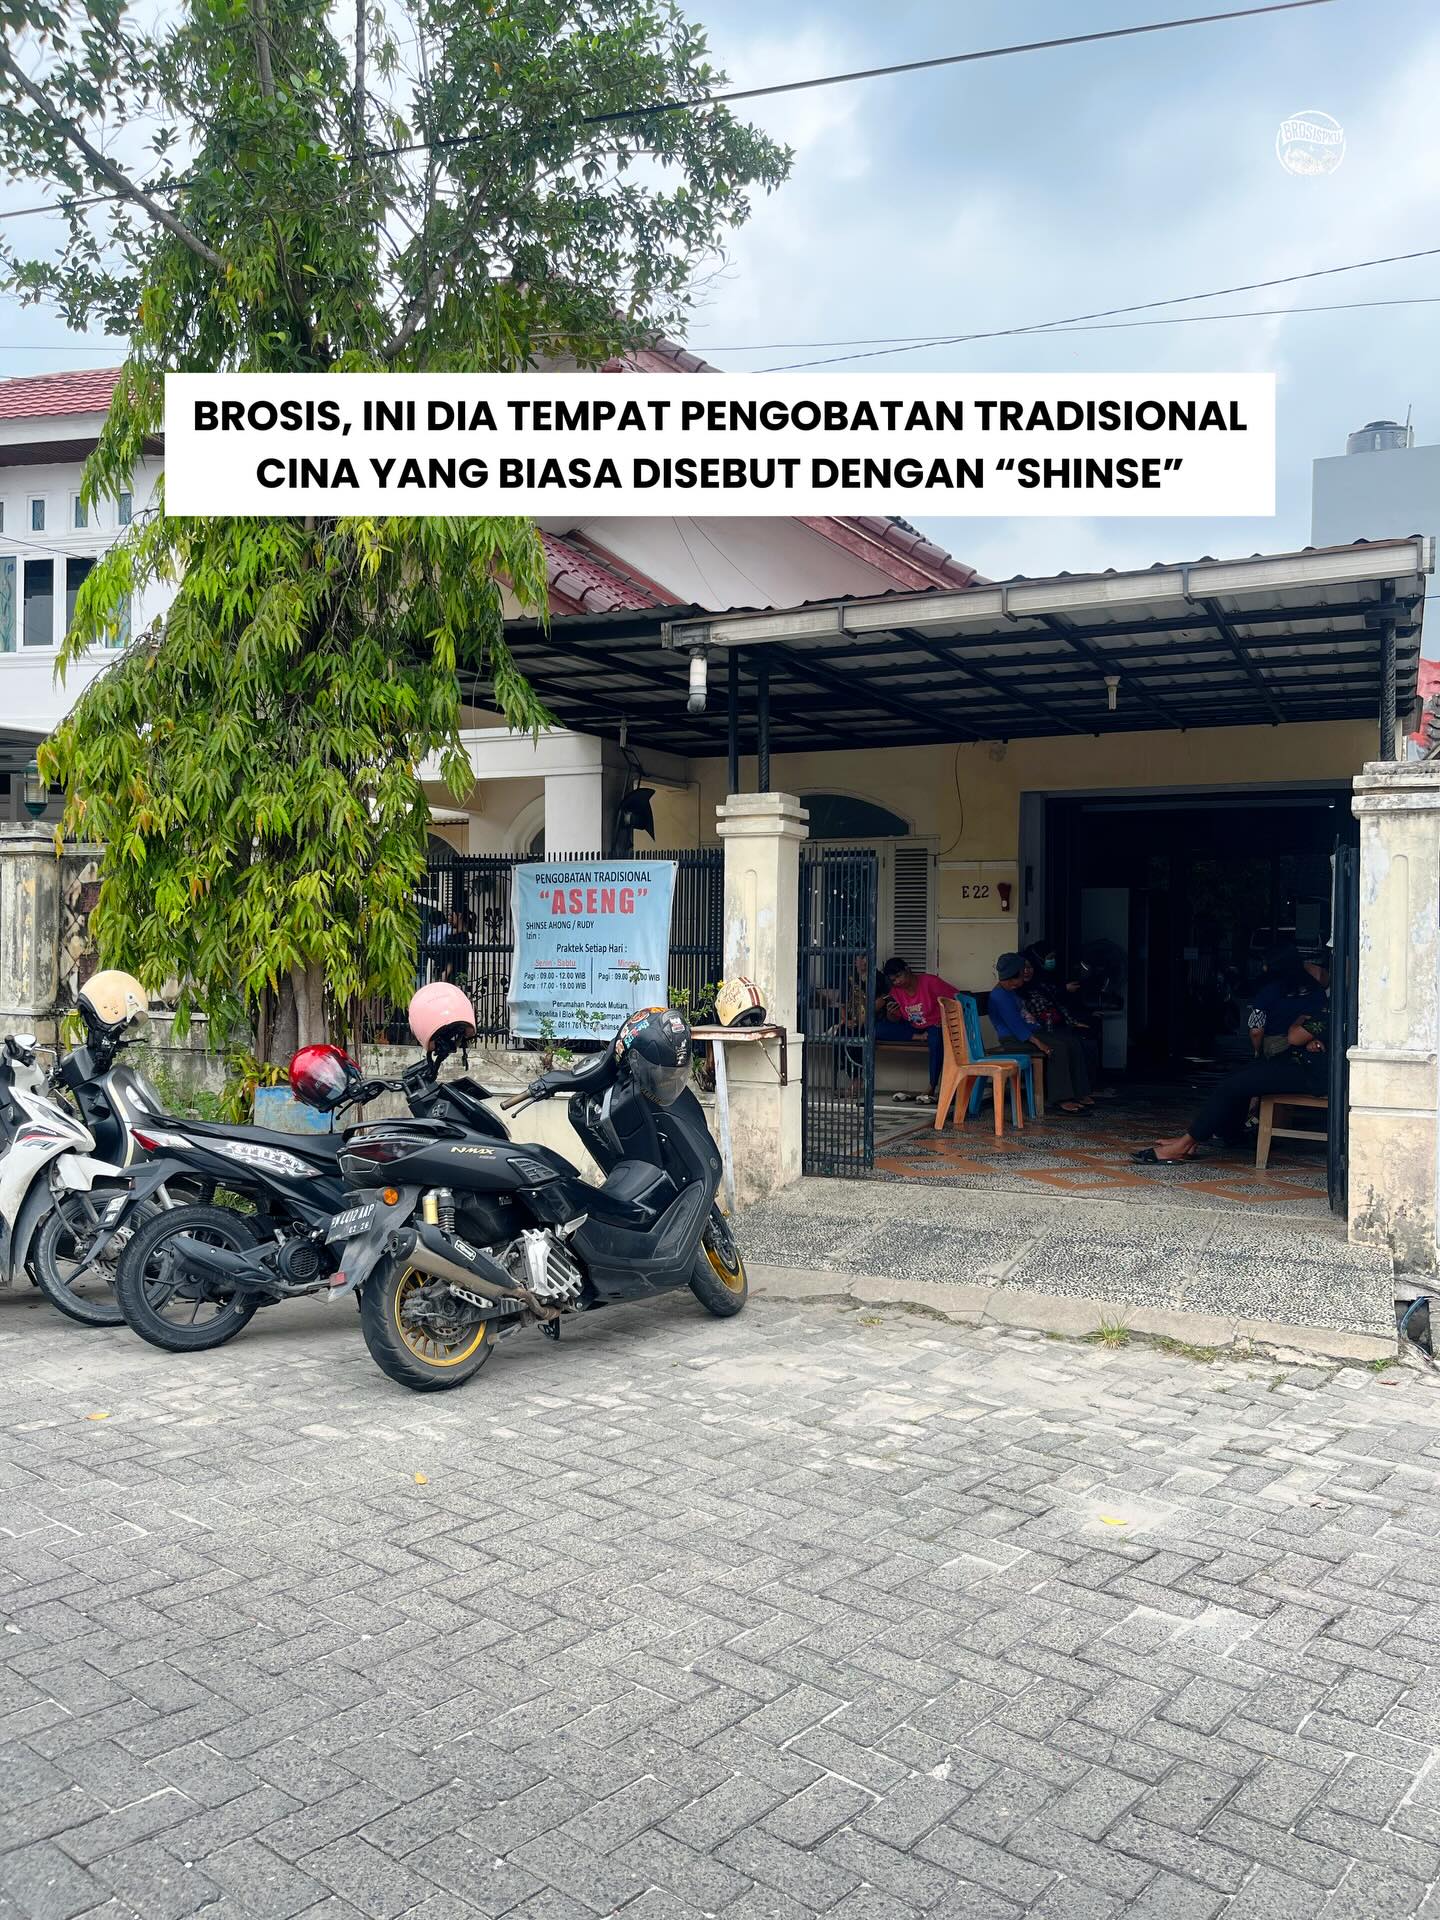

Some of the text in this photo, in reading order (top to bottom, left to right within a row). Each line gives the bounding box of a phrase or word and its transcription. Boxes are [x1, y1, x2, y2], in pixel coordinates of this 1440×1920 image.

[535, 871, 652, 884] PENGOBATAN TRADISIONAL
[961, 885, 989, 899] E 22
[539, 887, 648, 915] “ASENG”
[526, 920, 595, 930] SHINSE AHONG / RUDY
[526, 932, 537, 940] Izin
[556, 943, 583, 953] Praktek
[585, 943, 607, 955] Setiap
[608, 943, 623, 953] Hari
[524, 972, 536, 981] Pagi
[540, 972, 555, 980] 09.00
[559, 972, 574, 980] 12.00
[574, 972, 587, 980] WIB
[598, 972, 610, 981] Pagi
[523, 982, 536, 990] Sore
[540, 982, 555, 990] 17.00
[560, 982, 574, 990] 19.00
[575, 982, 587, 990] WIB
[585, 1001, 607, 1009] Pondok
[535, 1010, 558, 1018] Repelita
[562, 1010, 575, 1018] Blok
[558, 1021, 571, 1029] 0811
[572, 1021, 582, 1030] 761
[450, 1146, 496, 1155] NMAX
[358, 1203, 375, 1219] AAP
